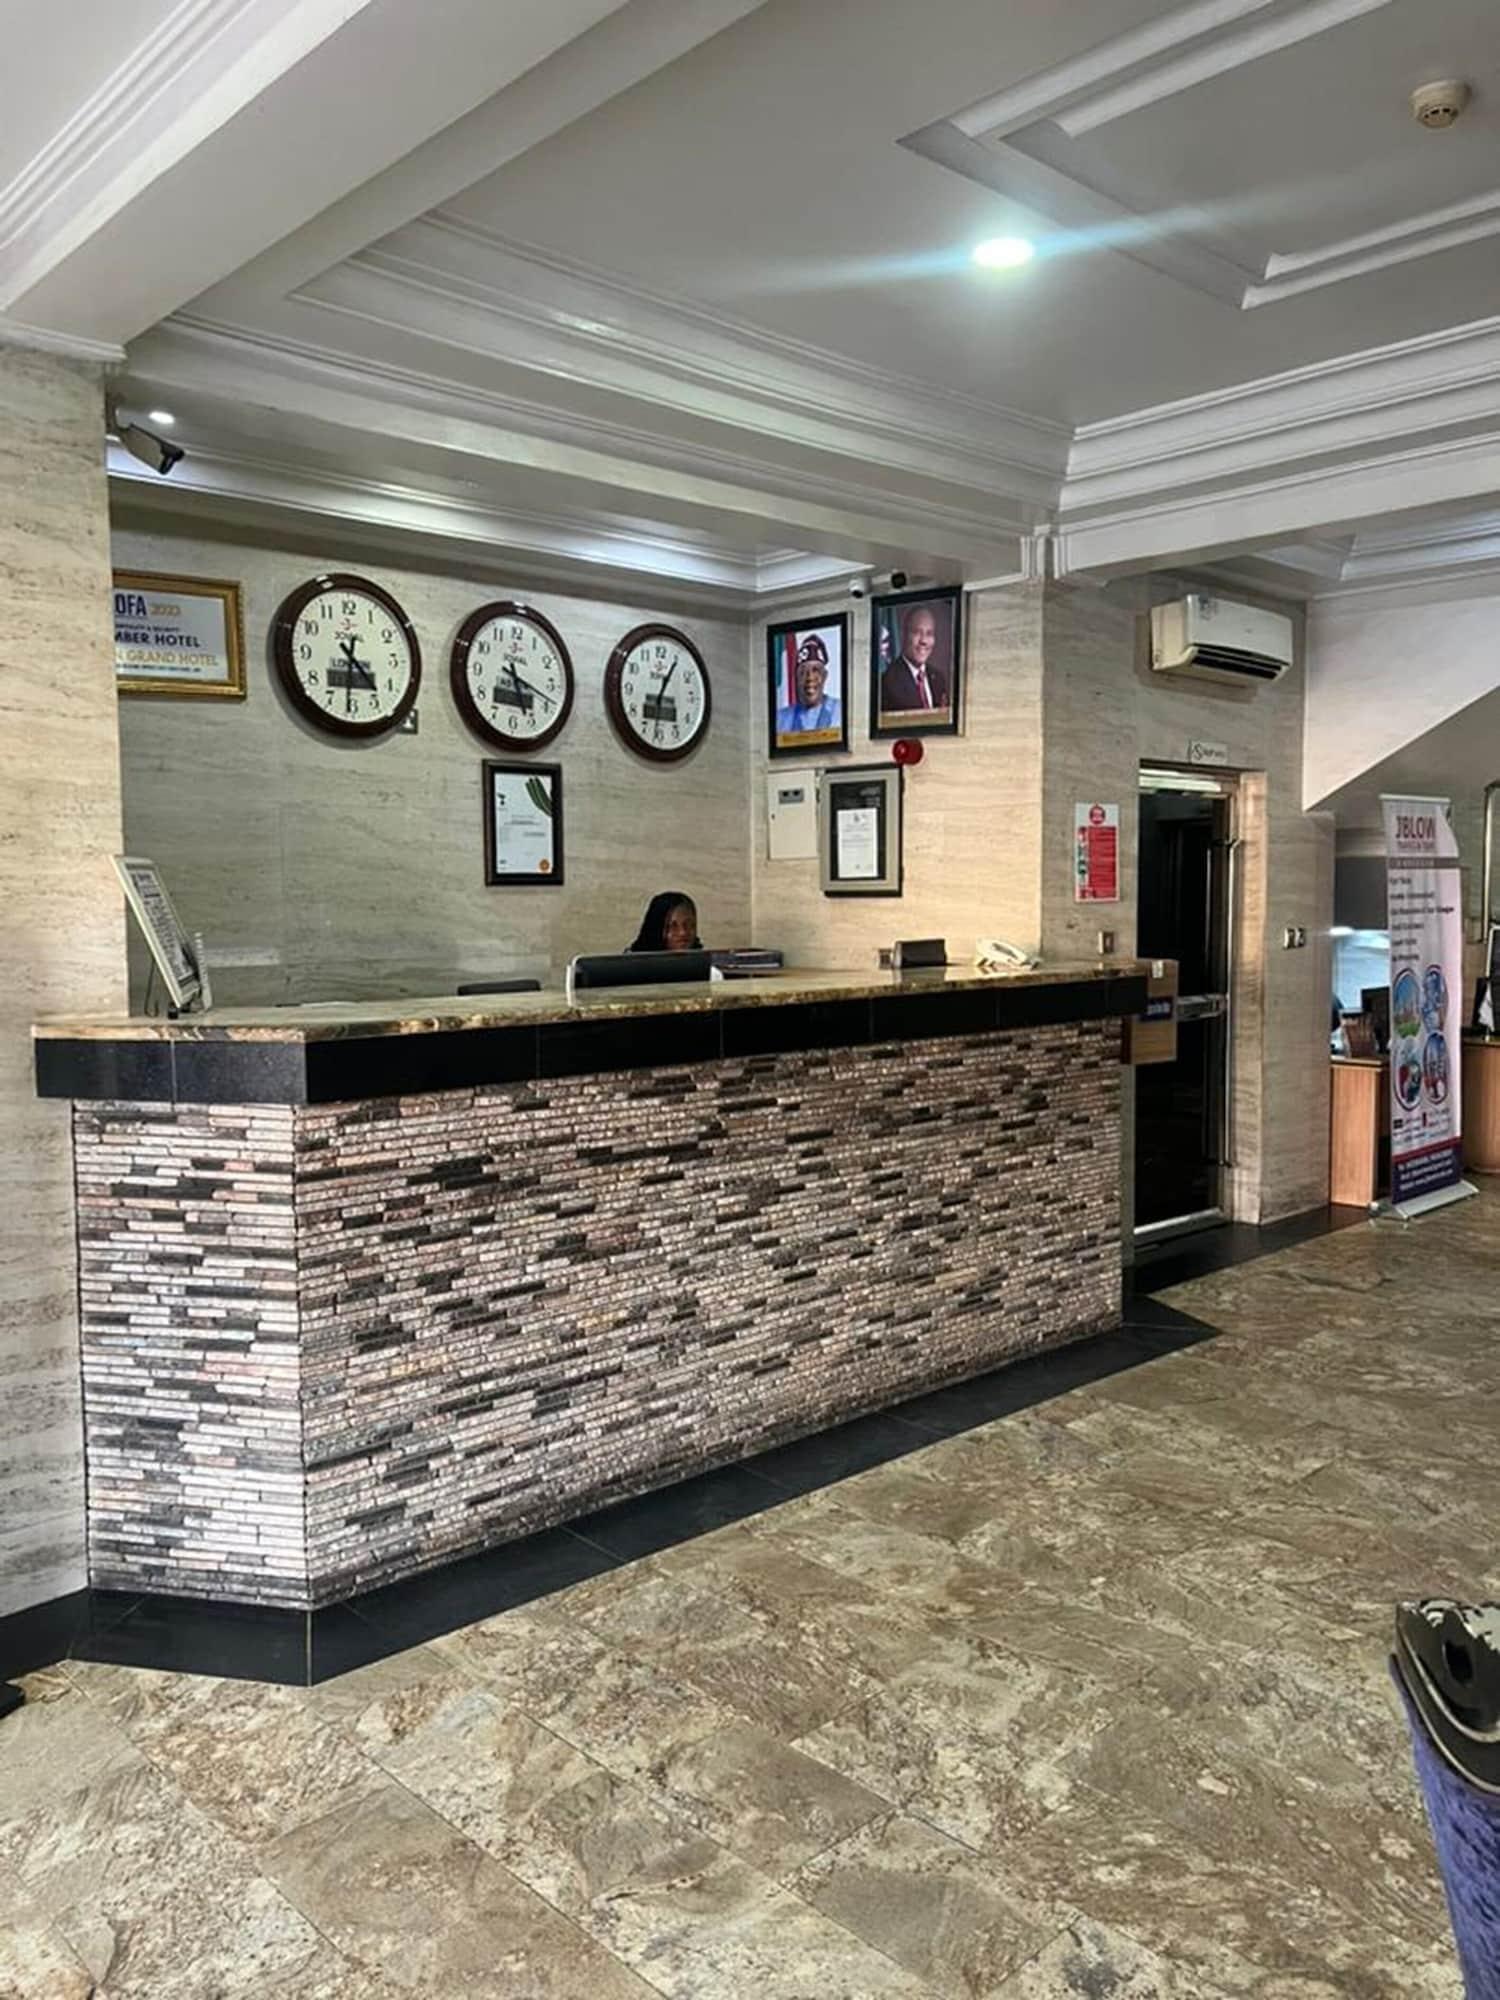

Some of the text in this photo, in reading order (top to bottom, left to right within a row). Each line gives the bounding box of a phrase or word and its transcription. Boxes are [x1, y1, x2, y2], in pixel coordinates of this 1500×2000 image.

[321, 604, 332, 619] 11
[342, 600, 356, 615] 12
[305, 620, 319, 636] 10
[382, 628, 392, 643] 2
[494, 627, 503, 641] 11
[512, 627, 523, 640] 12
[155, 634, 201, 648] HOTEL
[478, 640, 490, 654] 10
[126, 650, 176, 663] GRAND
[179, 652, 218, 667] HOTEL
[300, 644, 312, 660] 9
[640, 649, 650, 661] 11
[655, 646, 666, 659] 12
[388, 653, 399, 669] 3
[473, 662, 482, 675] 9
[542, 655, 552, 669] 2
[628, 662, 639, 675] 10
[308, 671, 319, 686] 8
[546, 677, 555, 692] 3
[683, 671, 692, 684] 2
[477, 685, 486, 700] 8
[624, 682, 633, 696] 9
[325, 690, 334, 705] 7
[369, 693, 380, 709] 5
[687, 690, 695, 704] 3
[491, 705, 498, 719] 7
[629, 703, 638, 718] 8
[508, 715, 518, 729] 6
[527, 712, 536, 727] 5
[671, 724, 679, 739] 5
